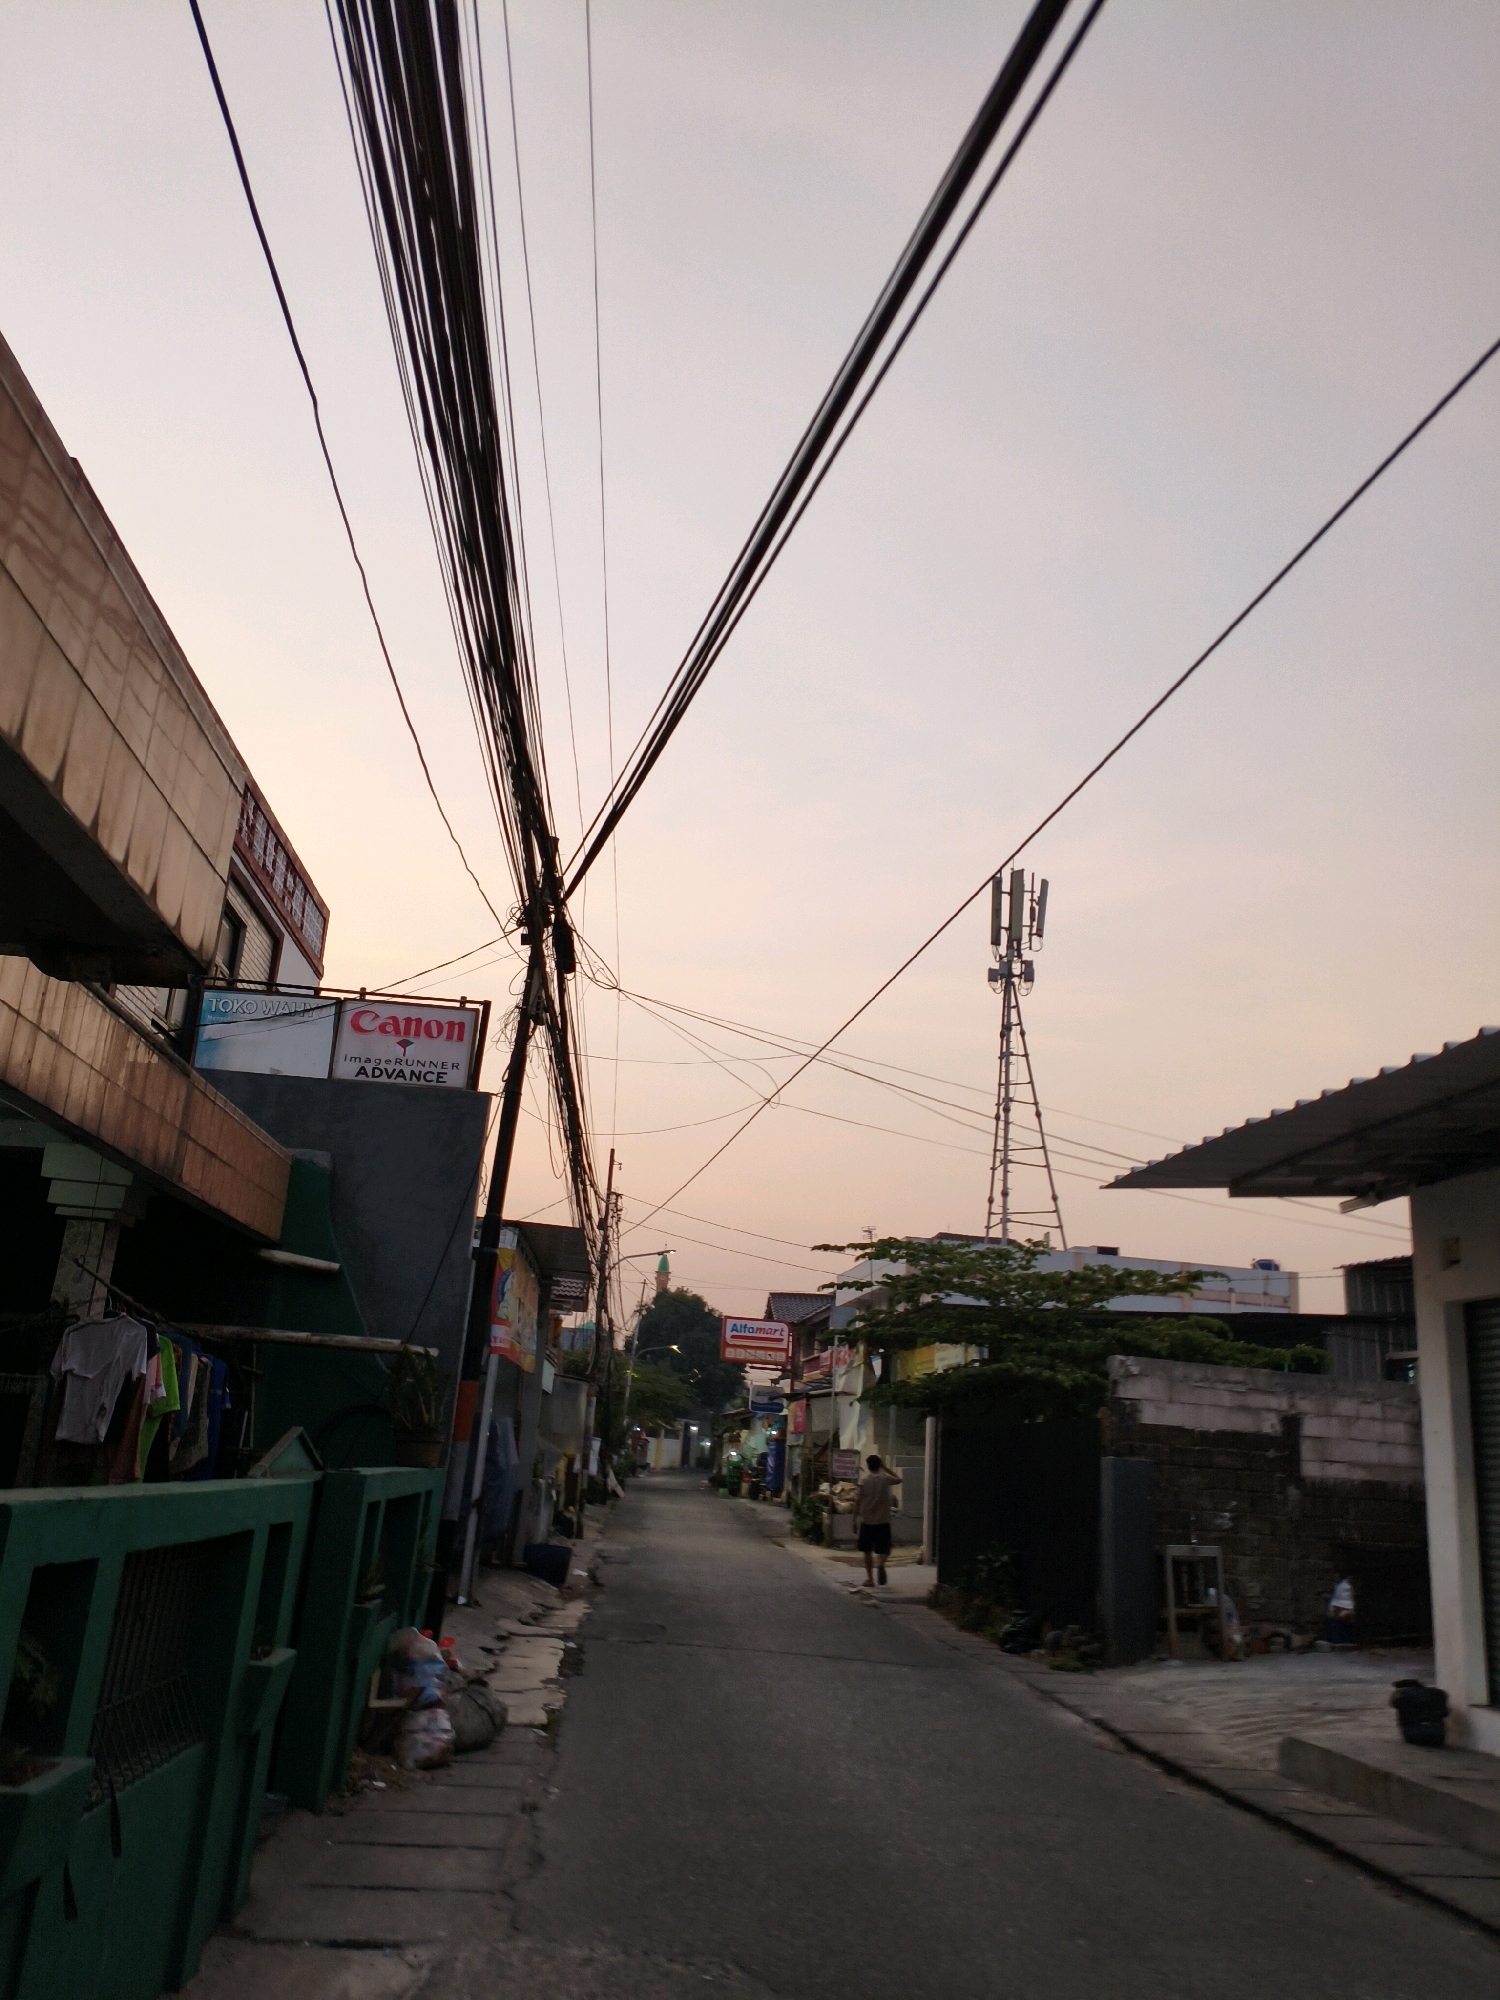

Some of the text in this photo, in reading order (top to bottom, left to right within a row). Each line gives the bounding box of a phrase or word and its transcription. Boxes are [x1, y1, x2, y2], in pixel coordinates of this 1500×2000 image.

[208, 998, 333, 1017] TOKO WAHY
[350, 1009, 466, 1042] Canon
[344, 1053, 460, 1070] imageRUNNER
[354, 1065, 448, 1083] ADVANCE
[730, 1322, 785, 1337] Alfamart
